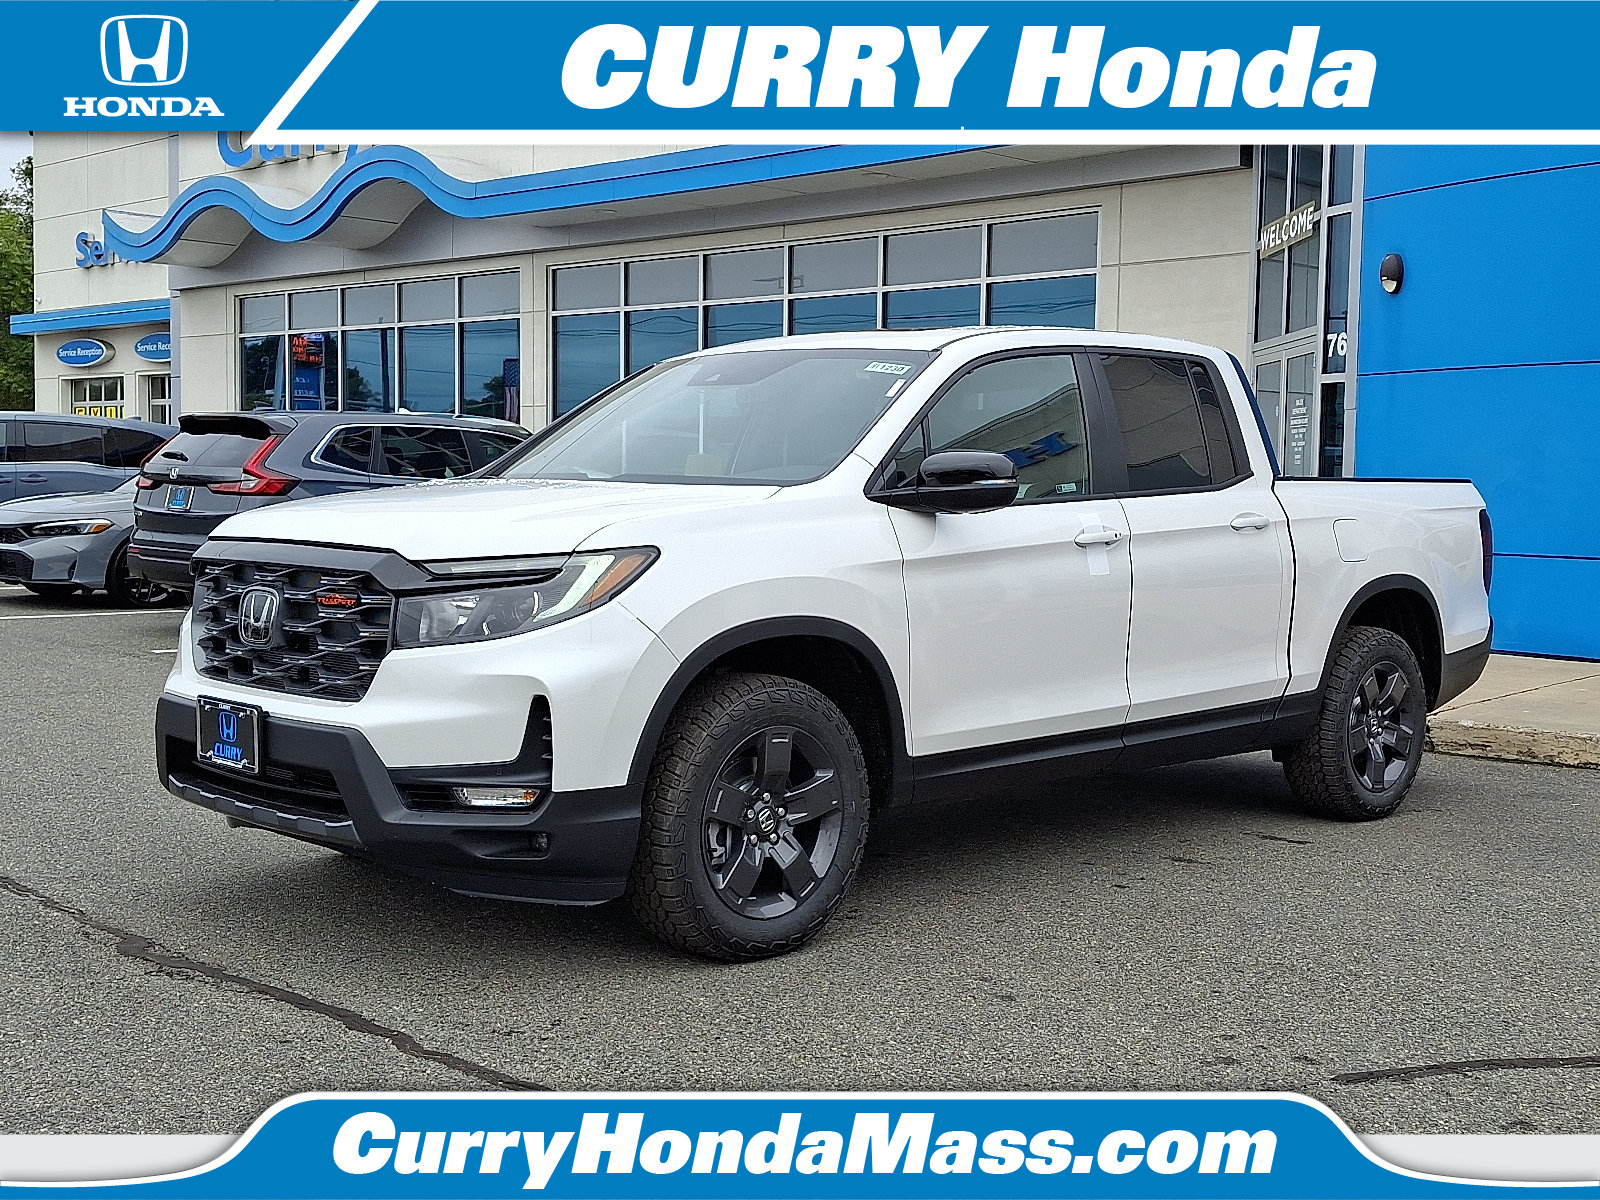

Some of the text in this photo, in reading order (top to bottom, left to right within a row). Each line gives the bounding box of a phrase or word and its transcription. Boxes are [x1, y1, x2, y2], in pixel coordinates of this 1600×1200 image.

[1260, 205, 1315, 252] WELCOME
[58, 346, 103, 358] Service Reception
[137, 342, 157, 352] Service
[1327, 331, 1348, 358] 76
[213, 742, 243, 761] CURRY
